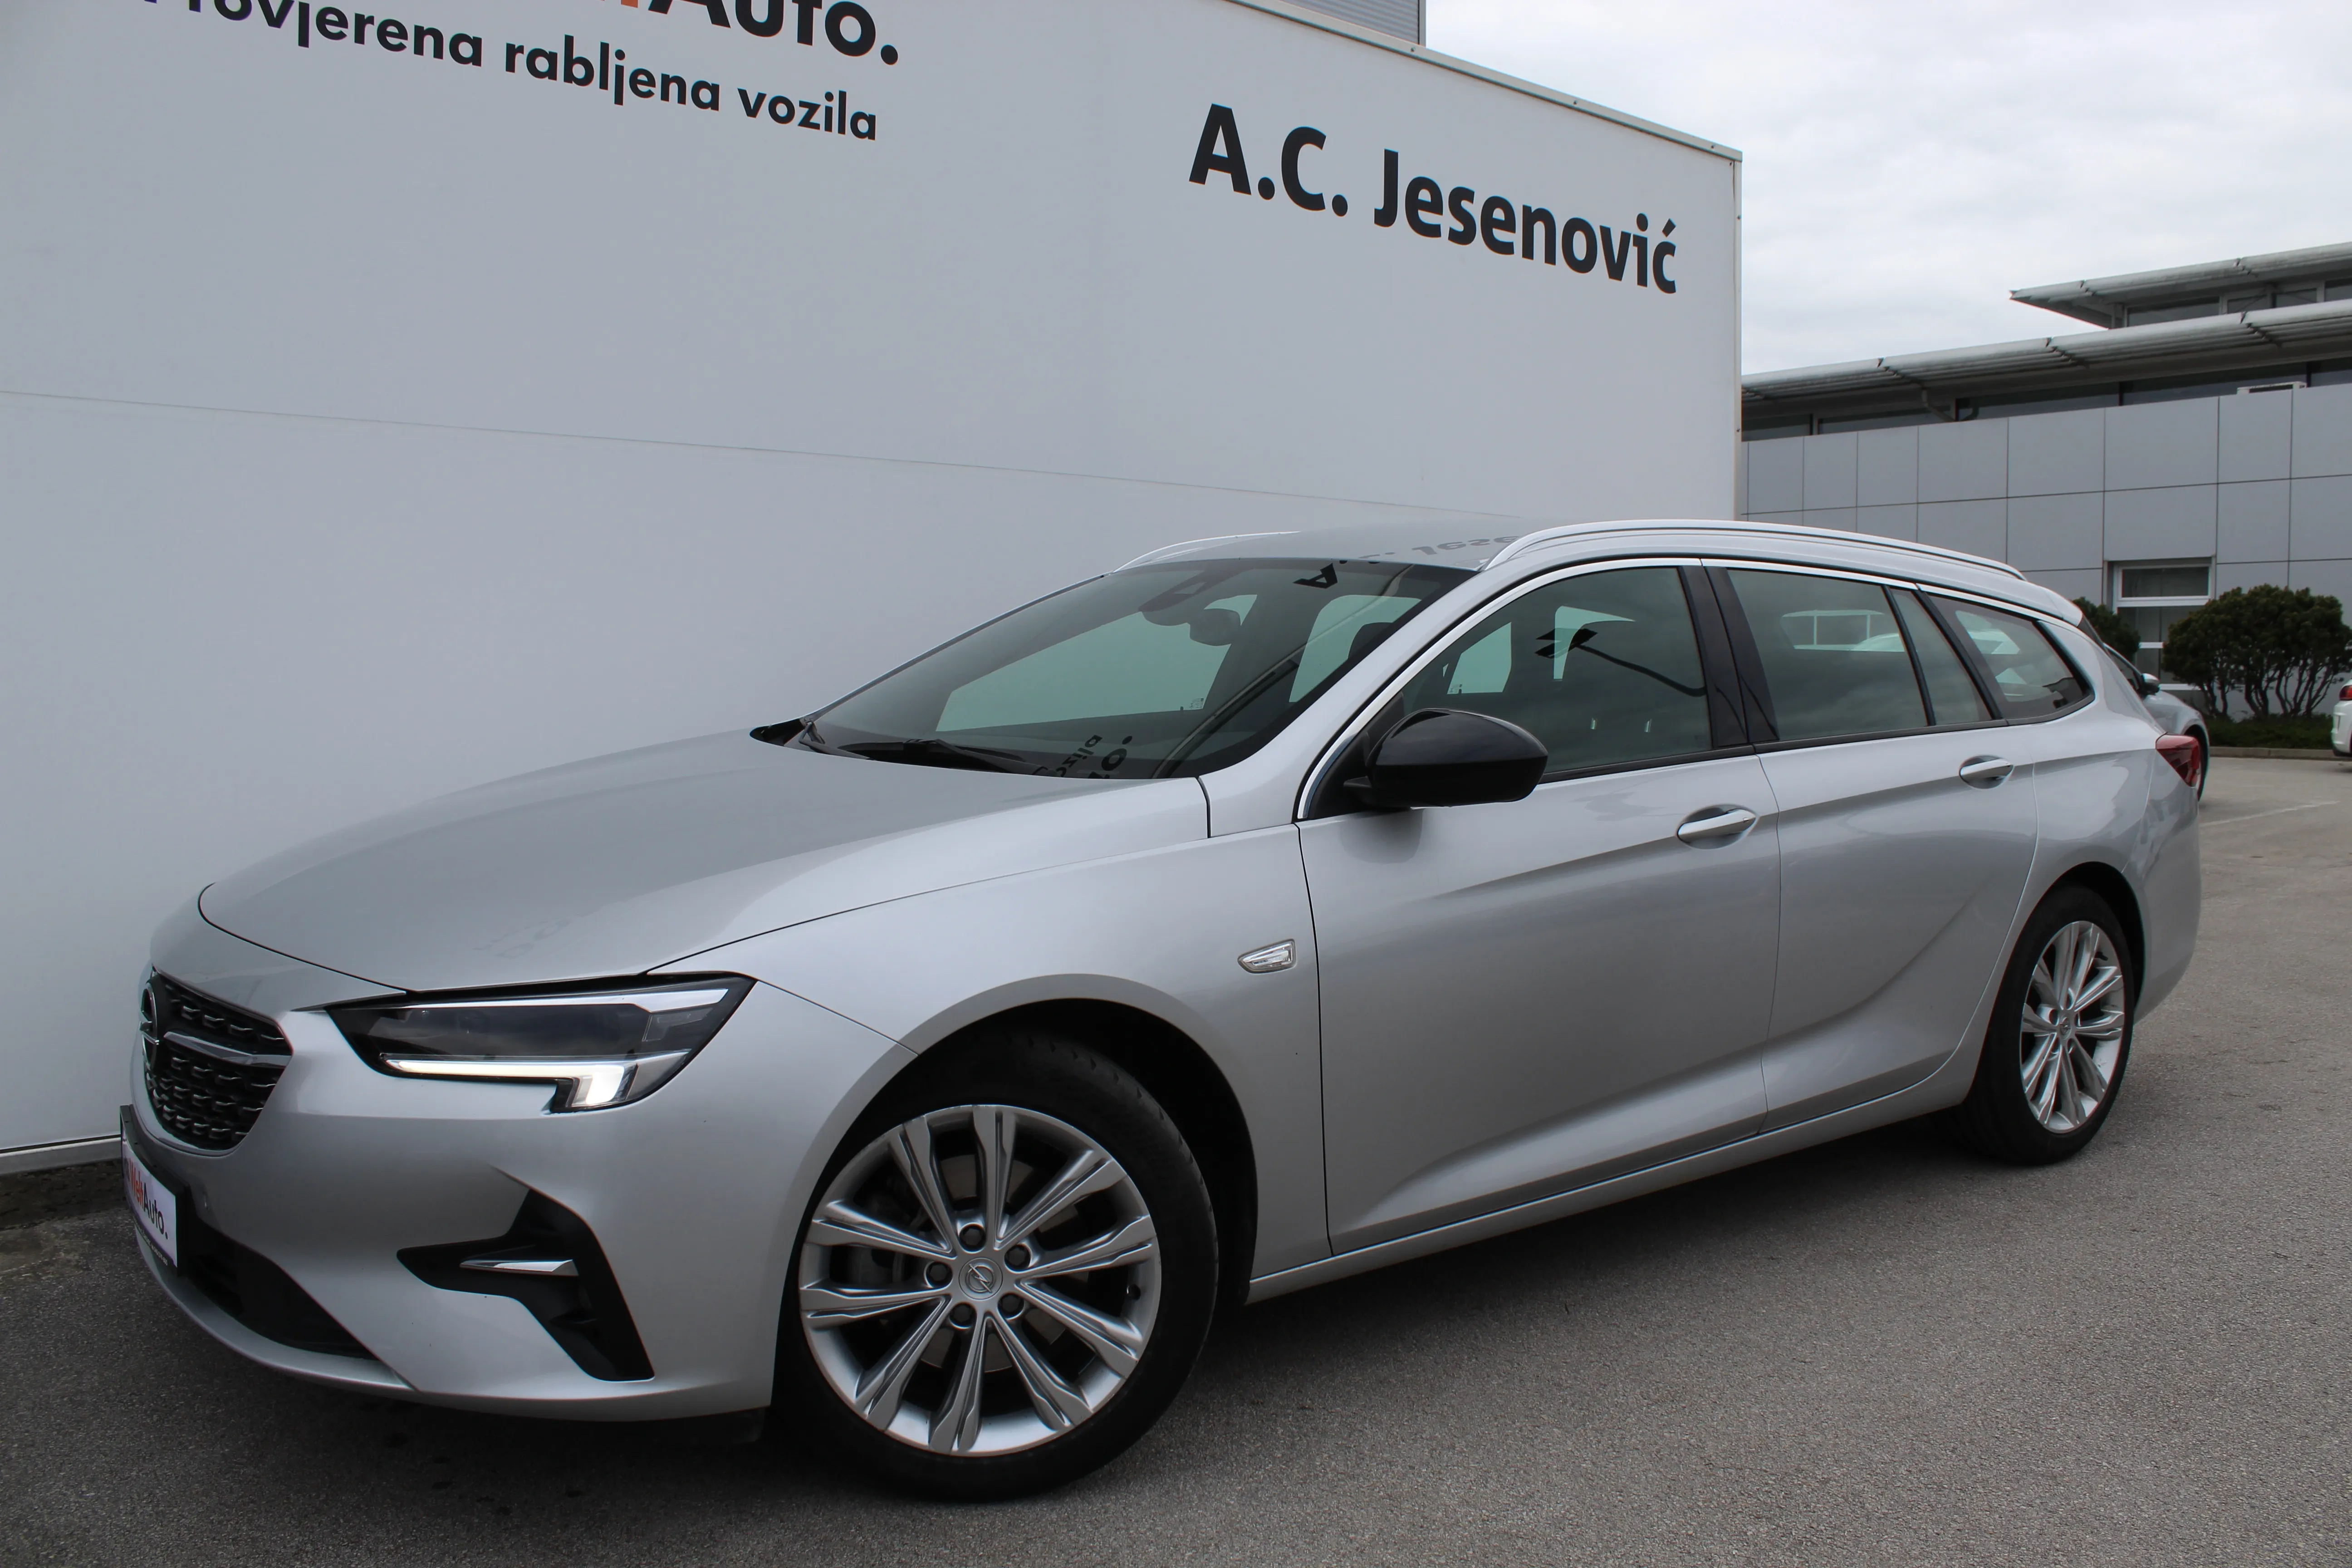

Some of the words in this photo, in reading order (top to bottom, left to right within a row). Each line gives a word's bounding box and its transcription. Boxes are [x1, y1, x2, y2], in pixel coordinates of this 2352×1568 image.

[144, 0, 482, 67] ovjerena
[505, 34, 720, 111] rabljena
[737, 88, 876, 141] vozila
[1189, 103, 1348, 217] A.C.
[1374, 149, 1676, 294] Jesenović
